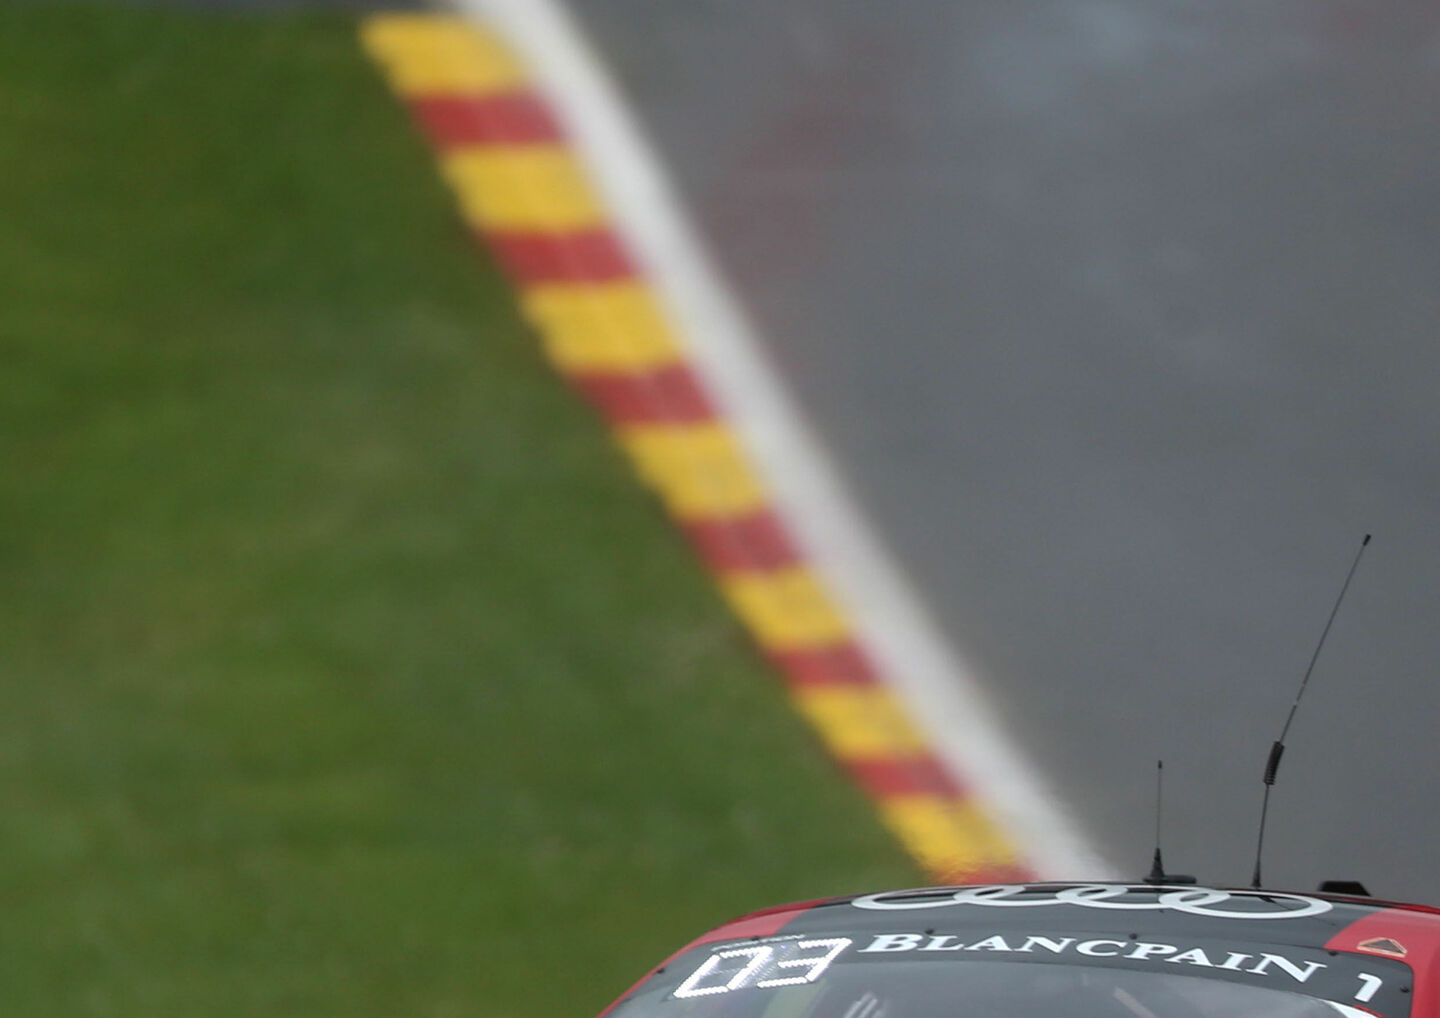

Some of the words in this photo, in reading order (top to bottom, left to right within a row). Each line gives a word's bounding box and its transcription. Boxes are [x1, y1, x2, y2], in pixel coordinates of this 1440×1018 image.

[673, 937, 853, 998] 03
[857, 933, 1328, 983] BLANCPAIN
[1354, 972, 1383, 1002] 1
